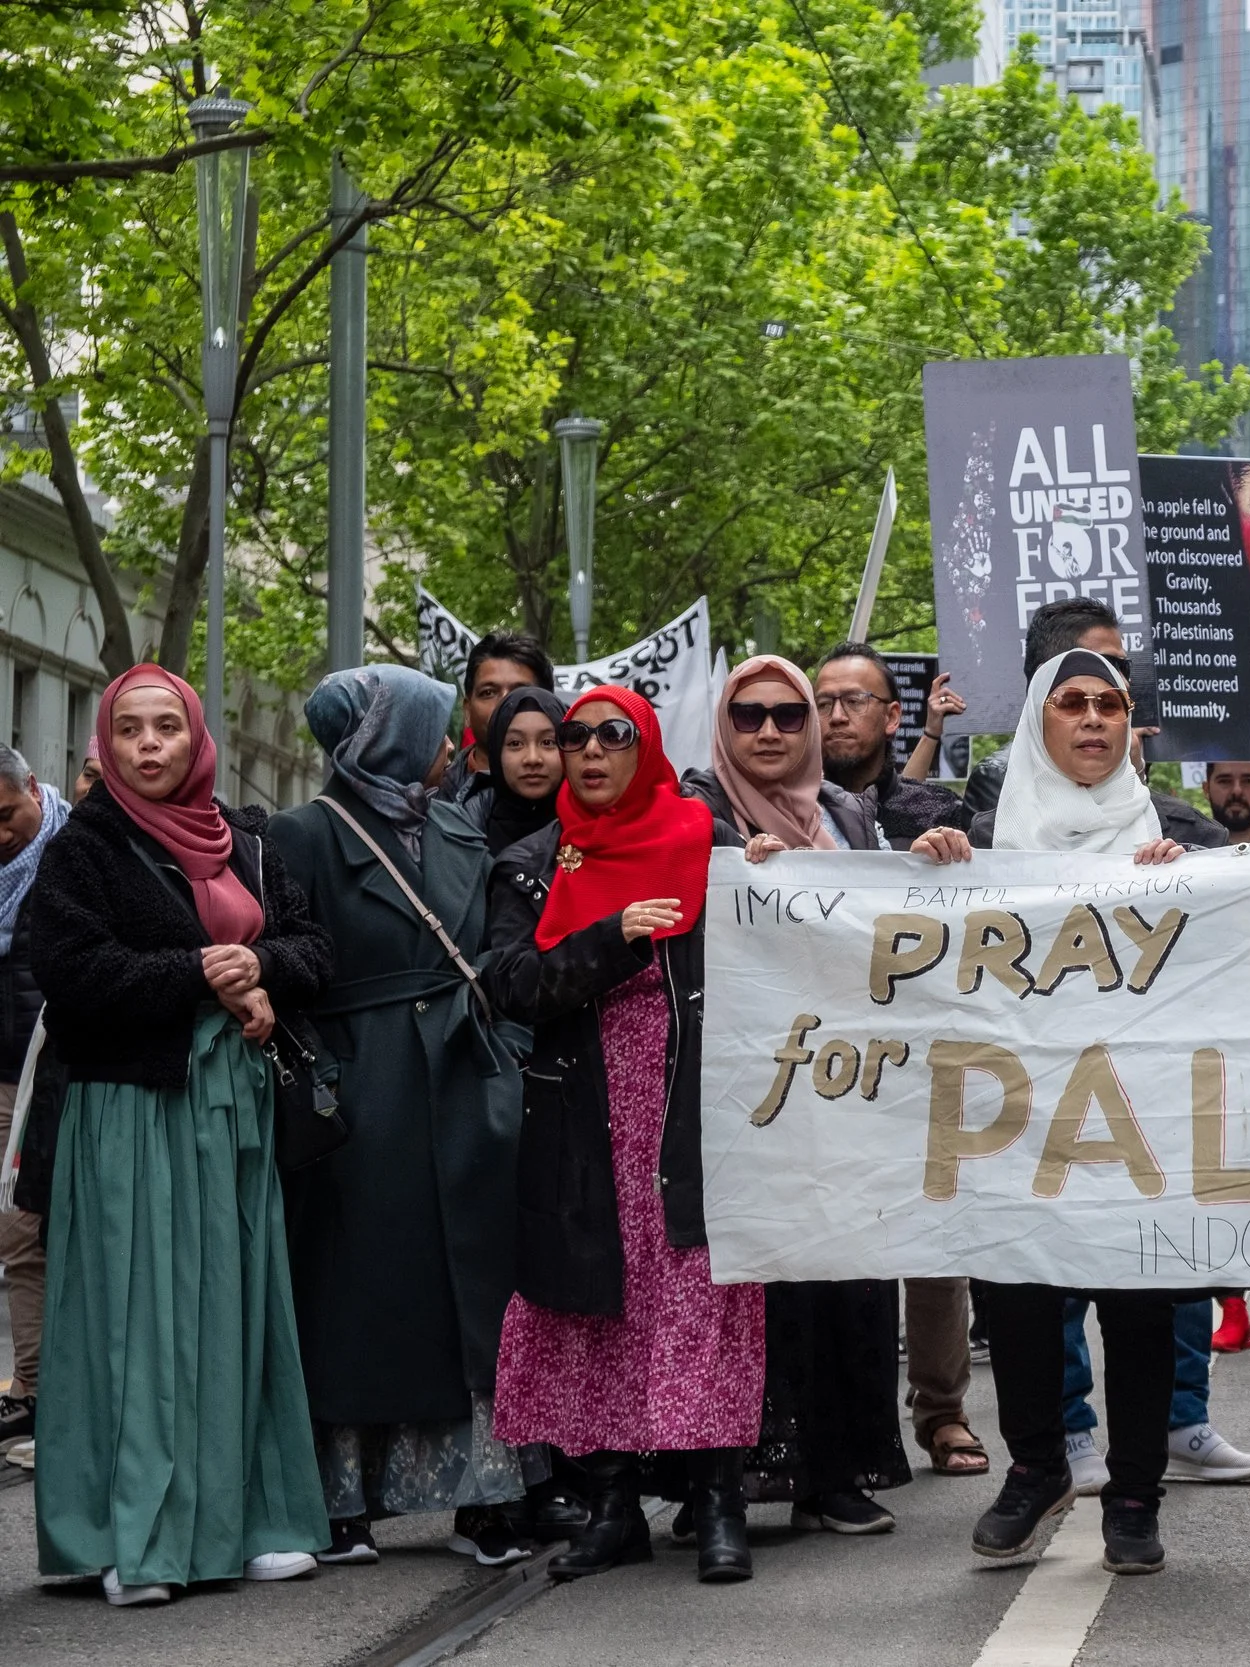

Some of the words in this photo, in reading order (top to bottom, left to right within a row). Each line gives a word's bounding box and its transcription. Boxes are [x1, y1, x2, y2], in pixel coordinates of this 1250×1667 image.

[1008, 423, 1131, 488] ALL
[1157, 497, 1190, 518] apple
[1191, 498, 1212, 515] fell
[1213, 501, 1227, 516] to
[1142, 521, 1159, 539] he
[1160, 523, 1204, 543] ground
[1207, 524, 1231, 541] and
[1012, 523, 1139, 581] FOR
[1145, 549, 1176, 564] wton
[1178, 548, 1243, 567] discovered
[1166, 571, 1213, 595] Gravity.
[1156, 596, 1222, 615] Thousands
[1163, 622, 1235, 642] Palestinians
[1154, 647, 1167, 666] all
[1169, 648, 1193, 667] and
[1195, 653, 1212, 667] no
[1213, 653, 1237, 668] one
[1158, 677, 1171, 692] as
[1173, 674, 1239, 693] discovered
[1162, 700, 1230, 723] Humanity.
[734, 885, 846, 926] IMCV
[903, 886, 1015, 909] BAITUL
[869, 902, 1190, 1006] PRAY
[749, 1013, 910, 1128] for
